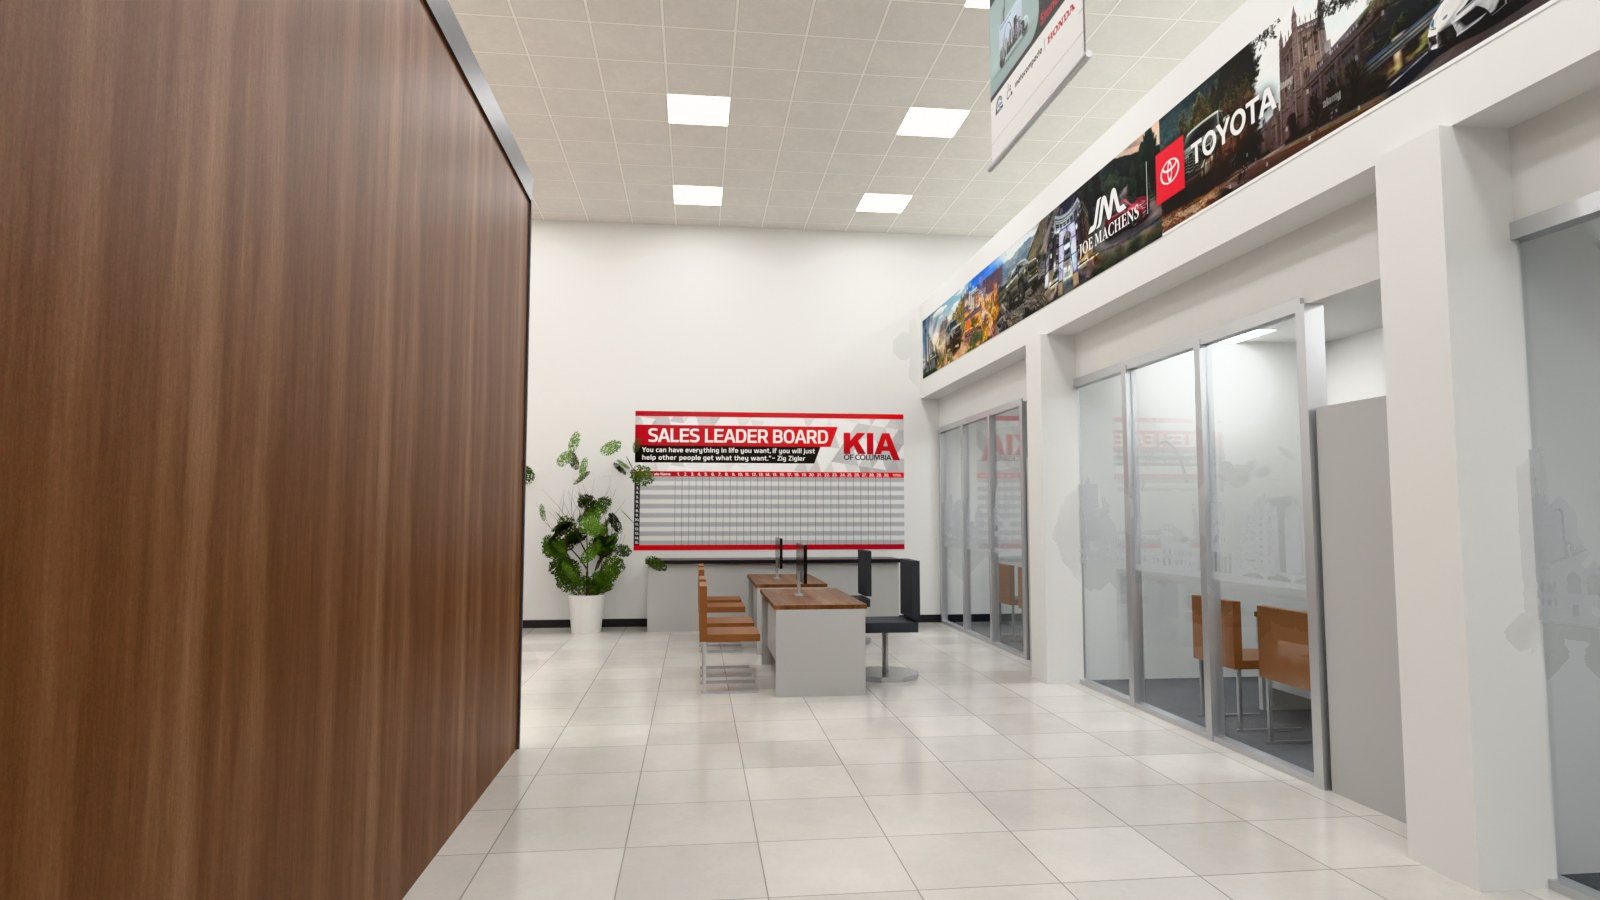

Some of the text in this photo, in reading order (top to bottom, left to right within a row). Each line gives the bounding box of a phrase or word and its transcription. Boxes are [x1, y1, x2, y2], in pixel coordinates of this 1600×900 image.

[1047, 4, 1076, 44] HONDA
[1190, 87, 1277, 164] TOYOTA
[1078, 206, 1140, 259] JOE MACHENS
[648, 428, 829, 444] SALES LEADER BOARD
[843, 432, 900, 460] KIA
